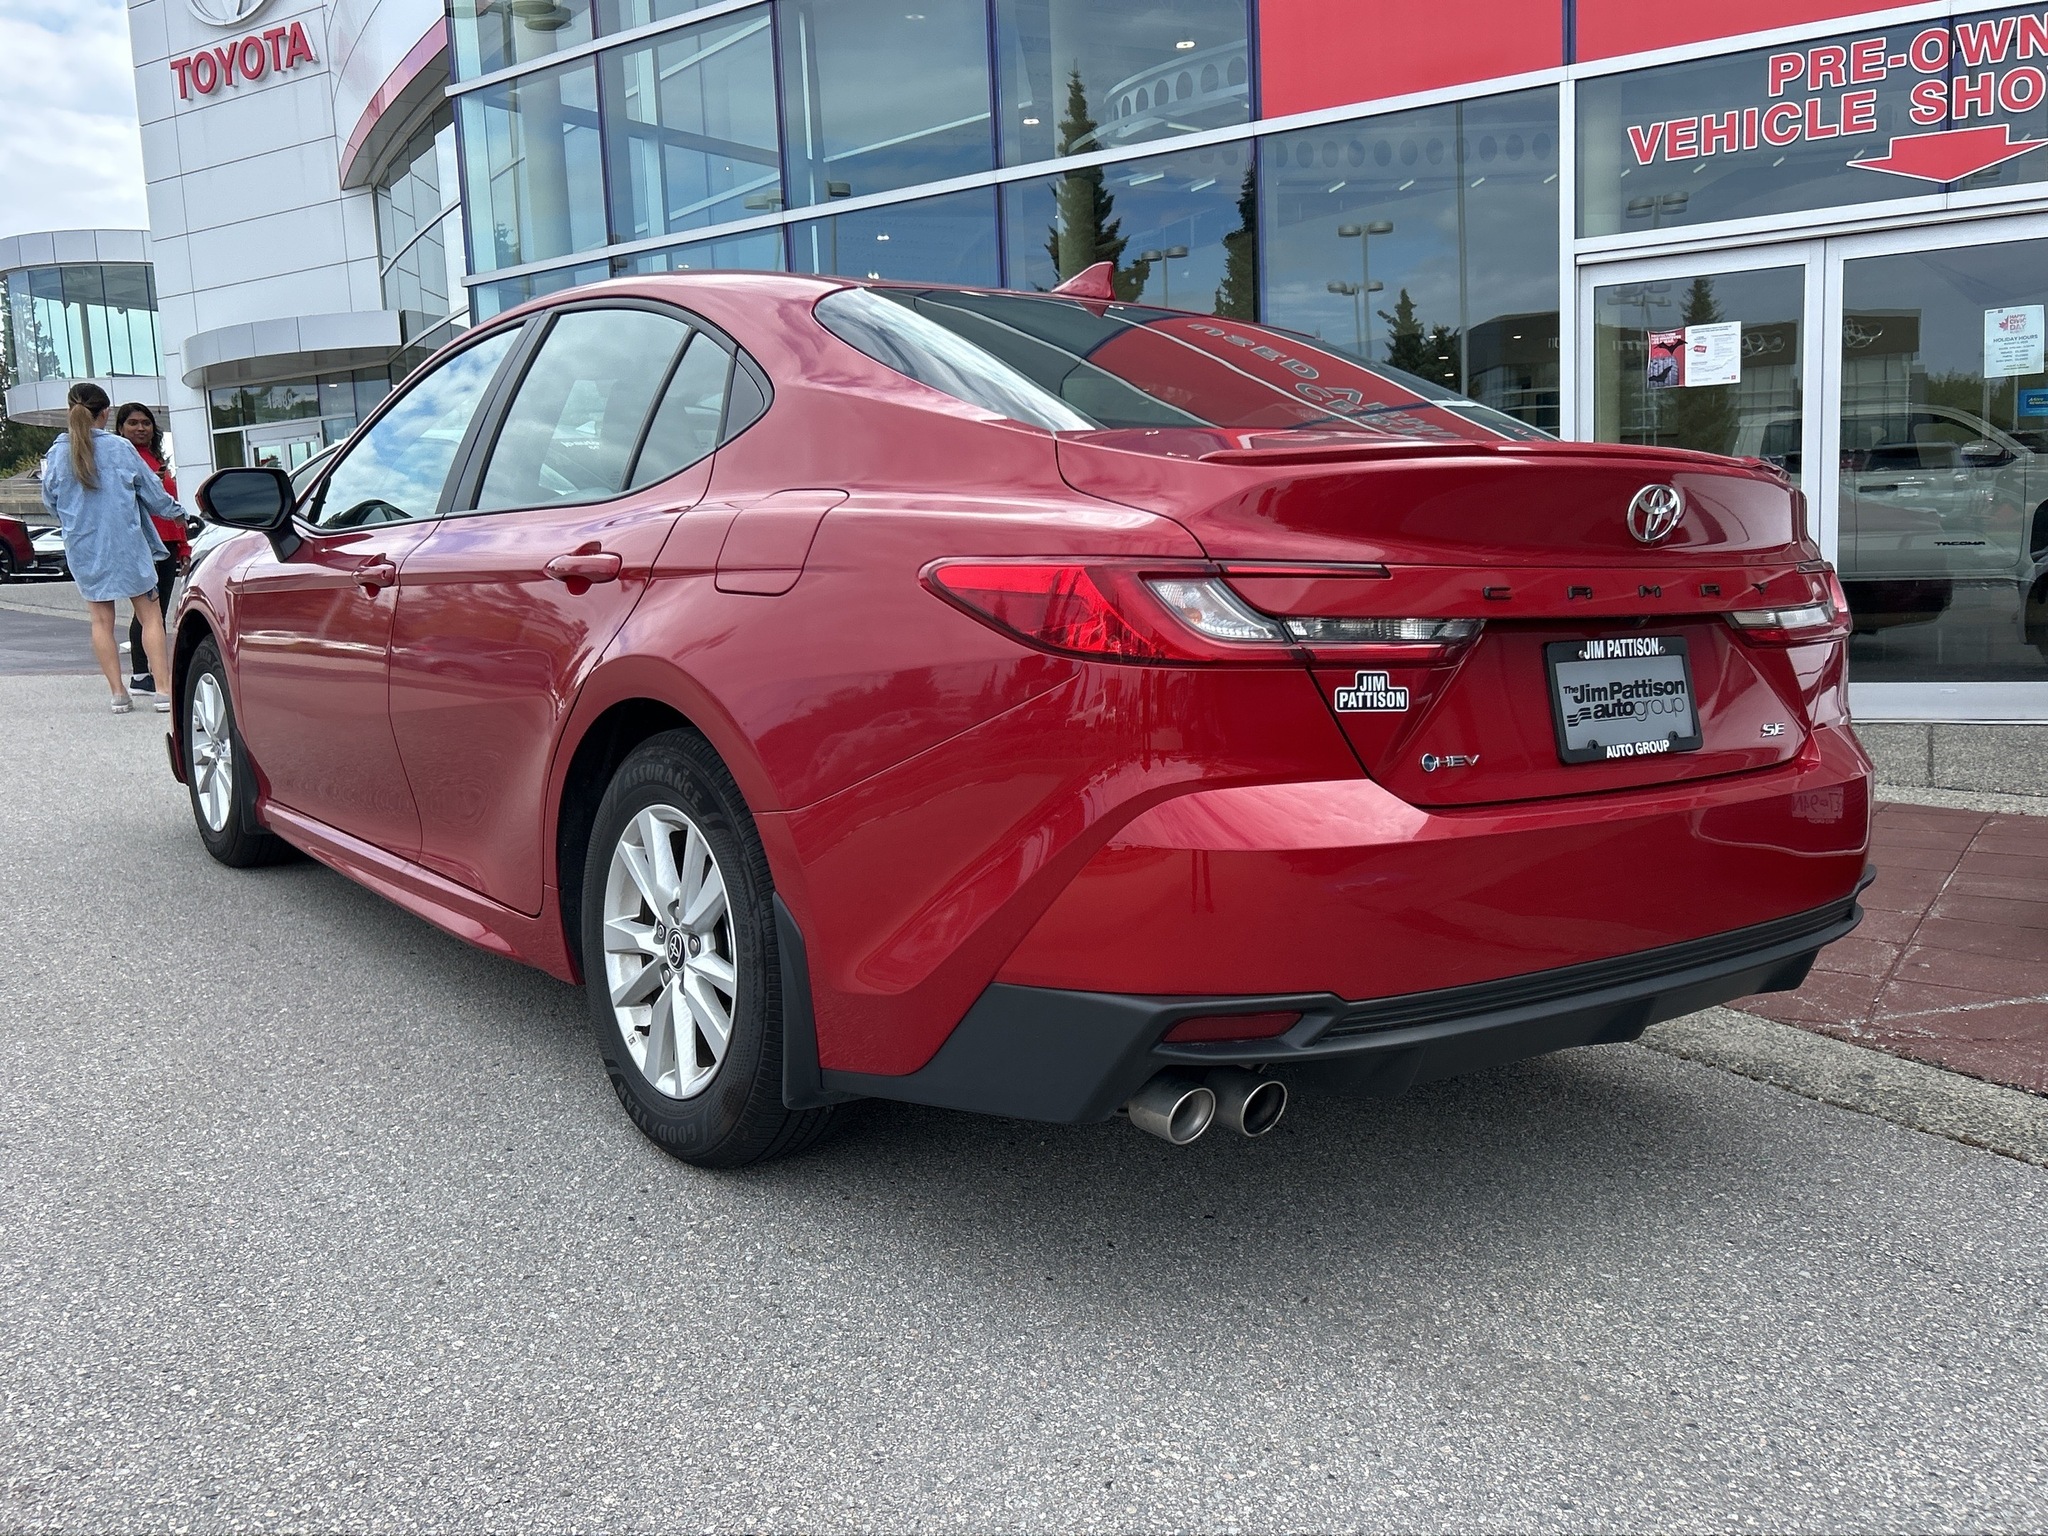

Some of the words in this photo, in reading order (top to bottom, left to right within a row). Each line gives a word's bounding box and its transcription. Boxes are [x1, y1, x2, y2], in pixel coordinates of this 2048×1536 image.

[170, 21, 316, 100] TOYOTA
[1627, 89, 1877, 165] VEHICLE
[1909, 65, 2048, 125] SHO
[1482, 582, 1768, 600] CAMRY
[1584, 640, 1605, 659] JIM
[1607, 638, 1659, 658] PATTISON
[1360, 675, 1385, 692] JIM
[1563, 685, 1579, 694] The
[1339, 691, 1405, 708] PATTISON
[1761, 722, 1785, 737] SE
[1606, 743, 1633, 758] AUTO
[1636, 739, 1670, 755] GROUP
[624, 763, 703, 809] ASSURANCE
